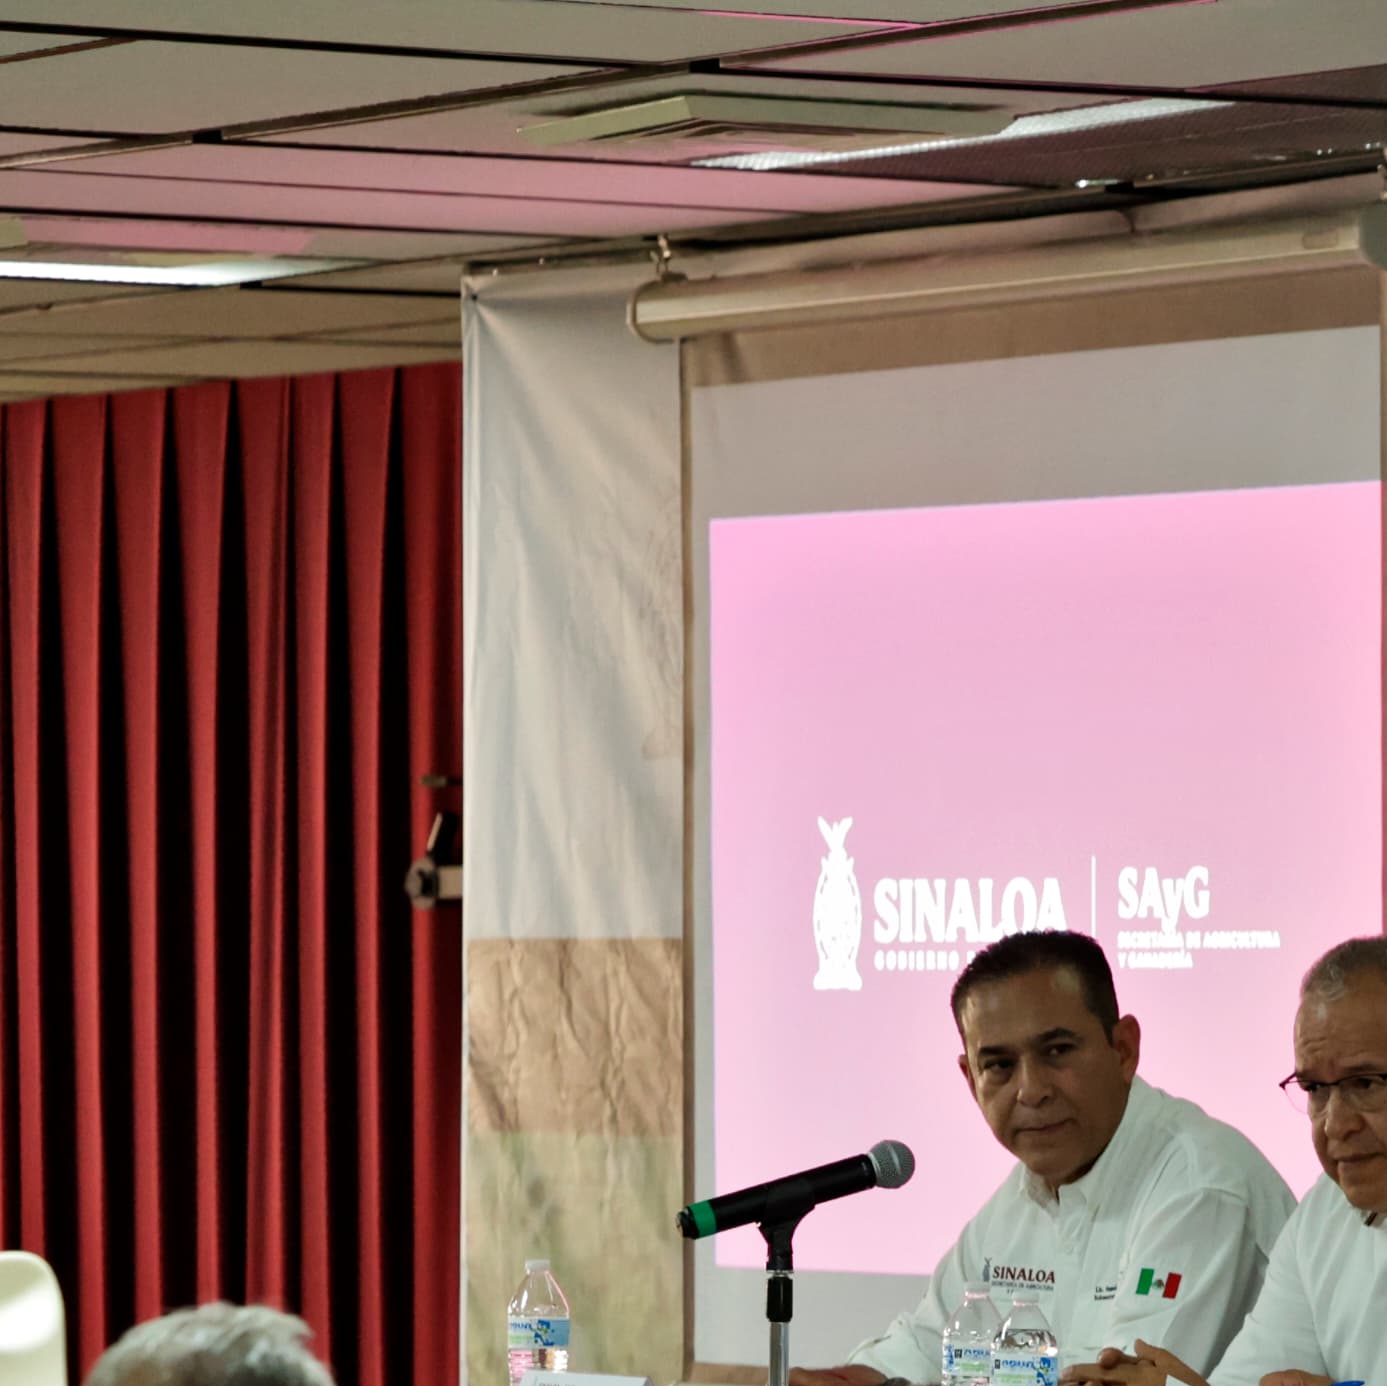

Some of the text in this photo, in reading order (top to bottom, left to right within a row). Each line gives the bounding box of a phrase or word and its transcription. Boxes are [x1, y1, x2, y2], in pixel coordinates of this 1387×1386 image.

[872, 876, 1070, 944] SINALOA
[1117, 865, 1211, 934] SAyG
[992, 1265, 1056, 1284] SINALOA
